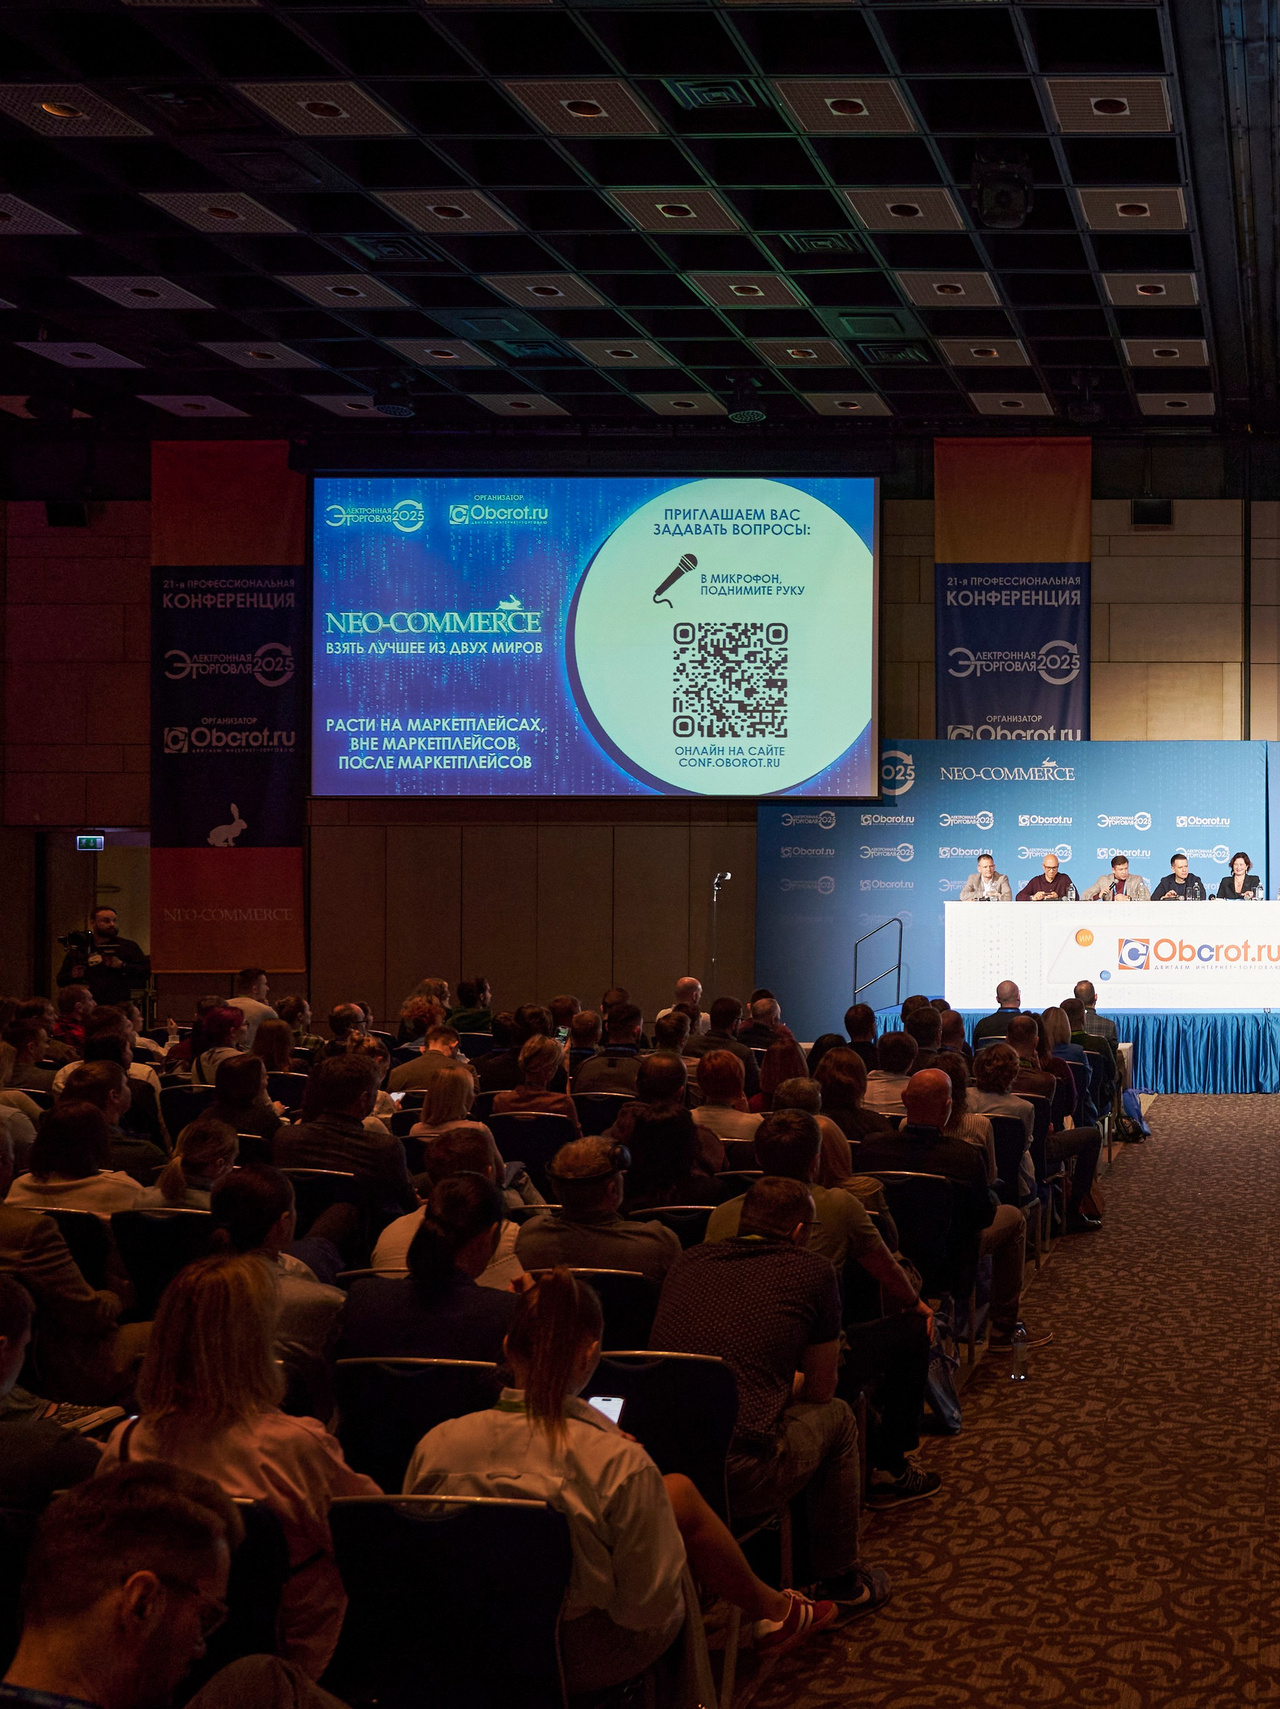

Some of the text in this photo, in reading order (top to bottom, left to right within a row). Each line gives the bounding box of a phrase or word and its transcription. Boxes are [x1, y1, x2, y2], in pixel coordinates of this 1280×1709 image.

[345, 514, 392, 526] ТОРГОВЛЯ
[392, 510, 424, 521] 2025
[664, 508, 801, 521] ПРИГЛАШАЕМ ВАС
[653, 523, 811, 537] ЗАДАВАТЬ ВОПРОСЫ:
[187, 579, 295, 589] ПРОФЕССИОНАЛЬНАЯ
[701, 574, 782, 585] В МИКРОФОН,
[947, 576, 1080, 586] 21-я ПРОФЕССИОНАЛЬНАЯ
[700, 586, 806, 596] ПОДНИМИТЕ РУКУ
[162, 592, 295, 610] КОНФЕРЕНЦИЯ
[946, 590, 1080, 607] КОНФЕРЕНЦИЯ
[325, 612, 542, 634] NEO-COMMERCE
[326, 641, 543, 655] ВЗЯТЬ ЛУЧШЕЕ ИЗ ДВУХ МИРОВ
[252, 657, 295, 672] 2025
[948, 647, 1036, 678] ЭЛЕКТРОННАЯ
[975, 660, 1037, 677] ТОРГОВЛЯ
[1037, 655, 1080, 669] 2025
[191, 663, 253, 679] ТОРГОВЛЯ
[201, 717, 258, 725] ОРГАНИЗАТОР
[326, 715, 545, 733] РАСТИ НА МАРКЕТПЛЕЙСАХ,
[986, 715, 1042, 723] ОРГАНИЗАТОР
[351, 734, 520, 751] ВНЕ МАРКЕТПЛЕЙСОВ,
[675, 744, 785, 756] ОНЛАЙН НА САЙТЕ
[339, 753, 532, 769] ПОСЛЕ МАРКЕТПЛЕЙСОВ
[679, 758, 780, 768] CONF.OBOROT.RU
[881, 765, 916, 780] 025
[940, 767, 1076, 781] NEO-COMMERCE
[1079, 934, 1092, 942] ИМ
